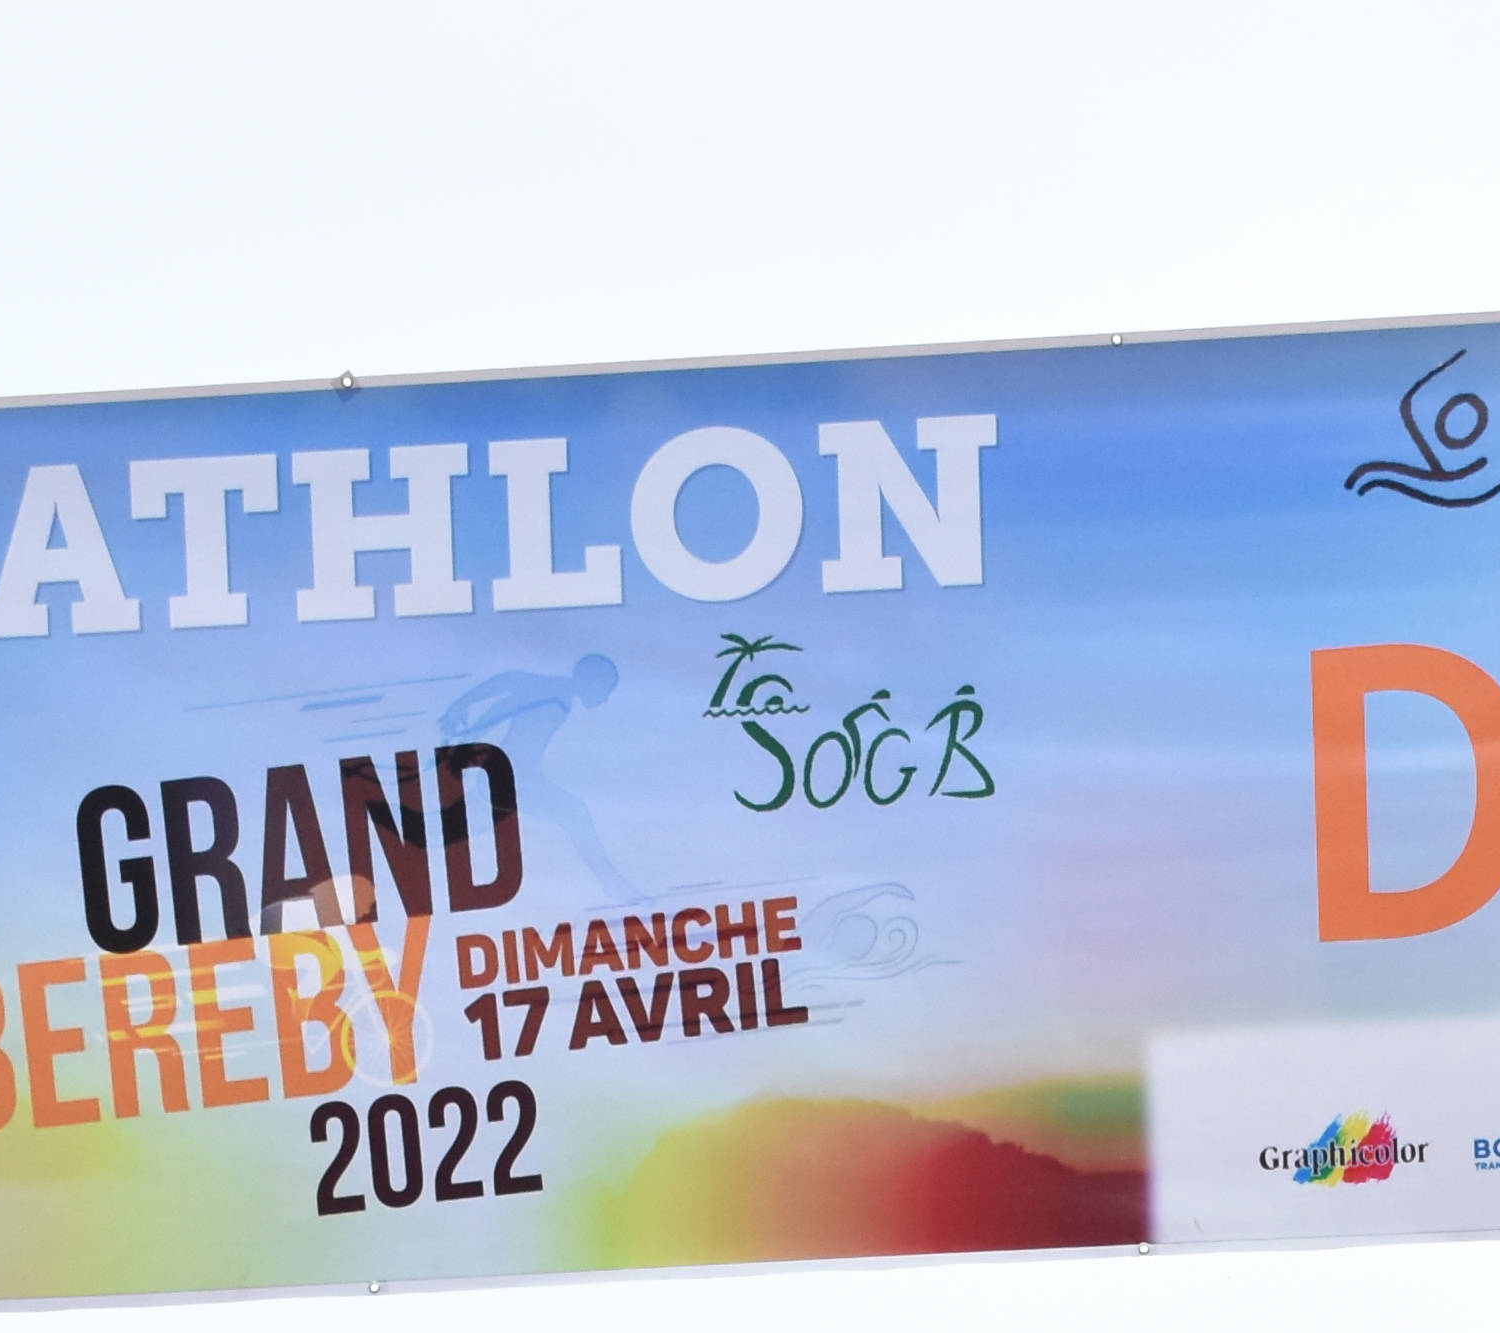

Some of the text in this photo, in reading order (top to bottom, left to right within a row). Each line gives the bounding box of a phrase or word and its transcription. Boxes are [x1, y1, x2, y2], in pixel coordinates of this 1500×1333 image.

[75, 741, 524, 955] GRAND
[455, 895, 802, 990] DIMANCHE
[463, 957, 810, 1061] 17 AVRIL
[309, 1079, 544, 1217] 2022
[1258, 1138, 1430, 1177] Graphicolor
